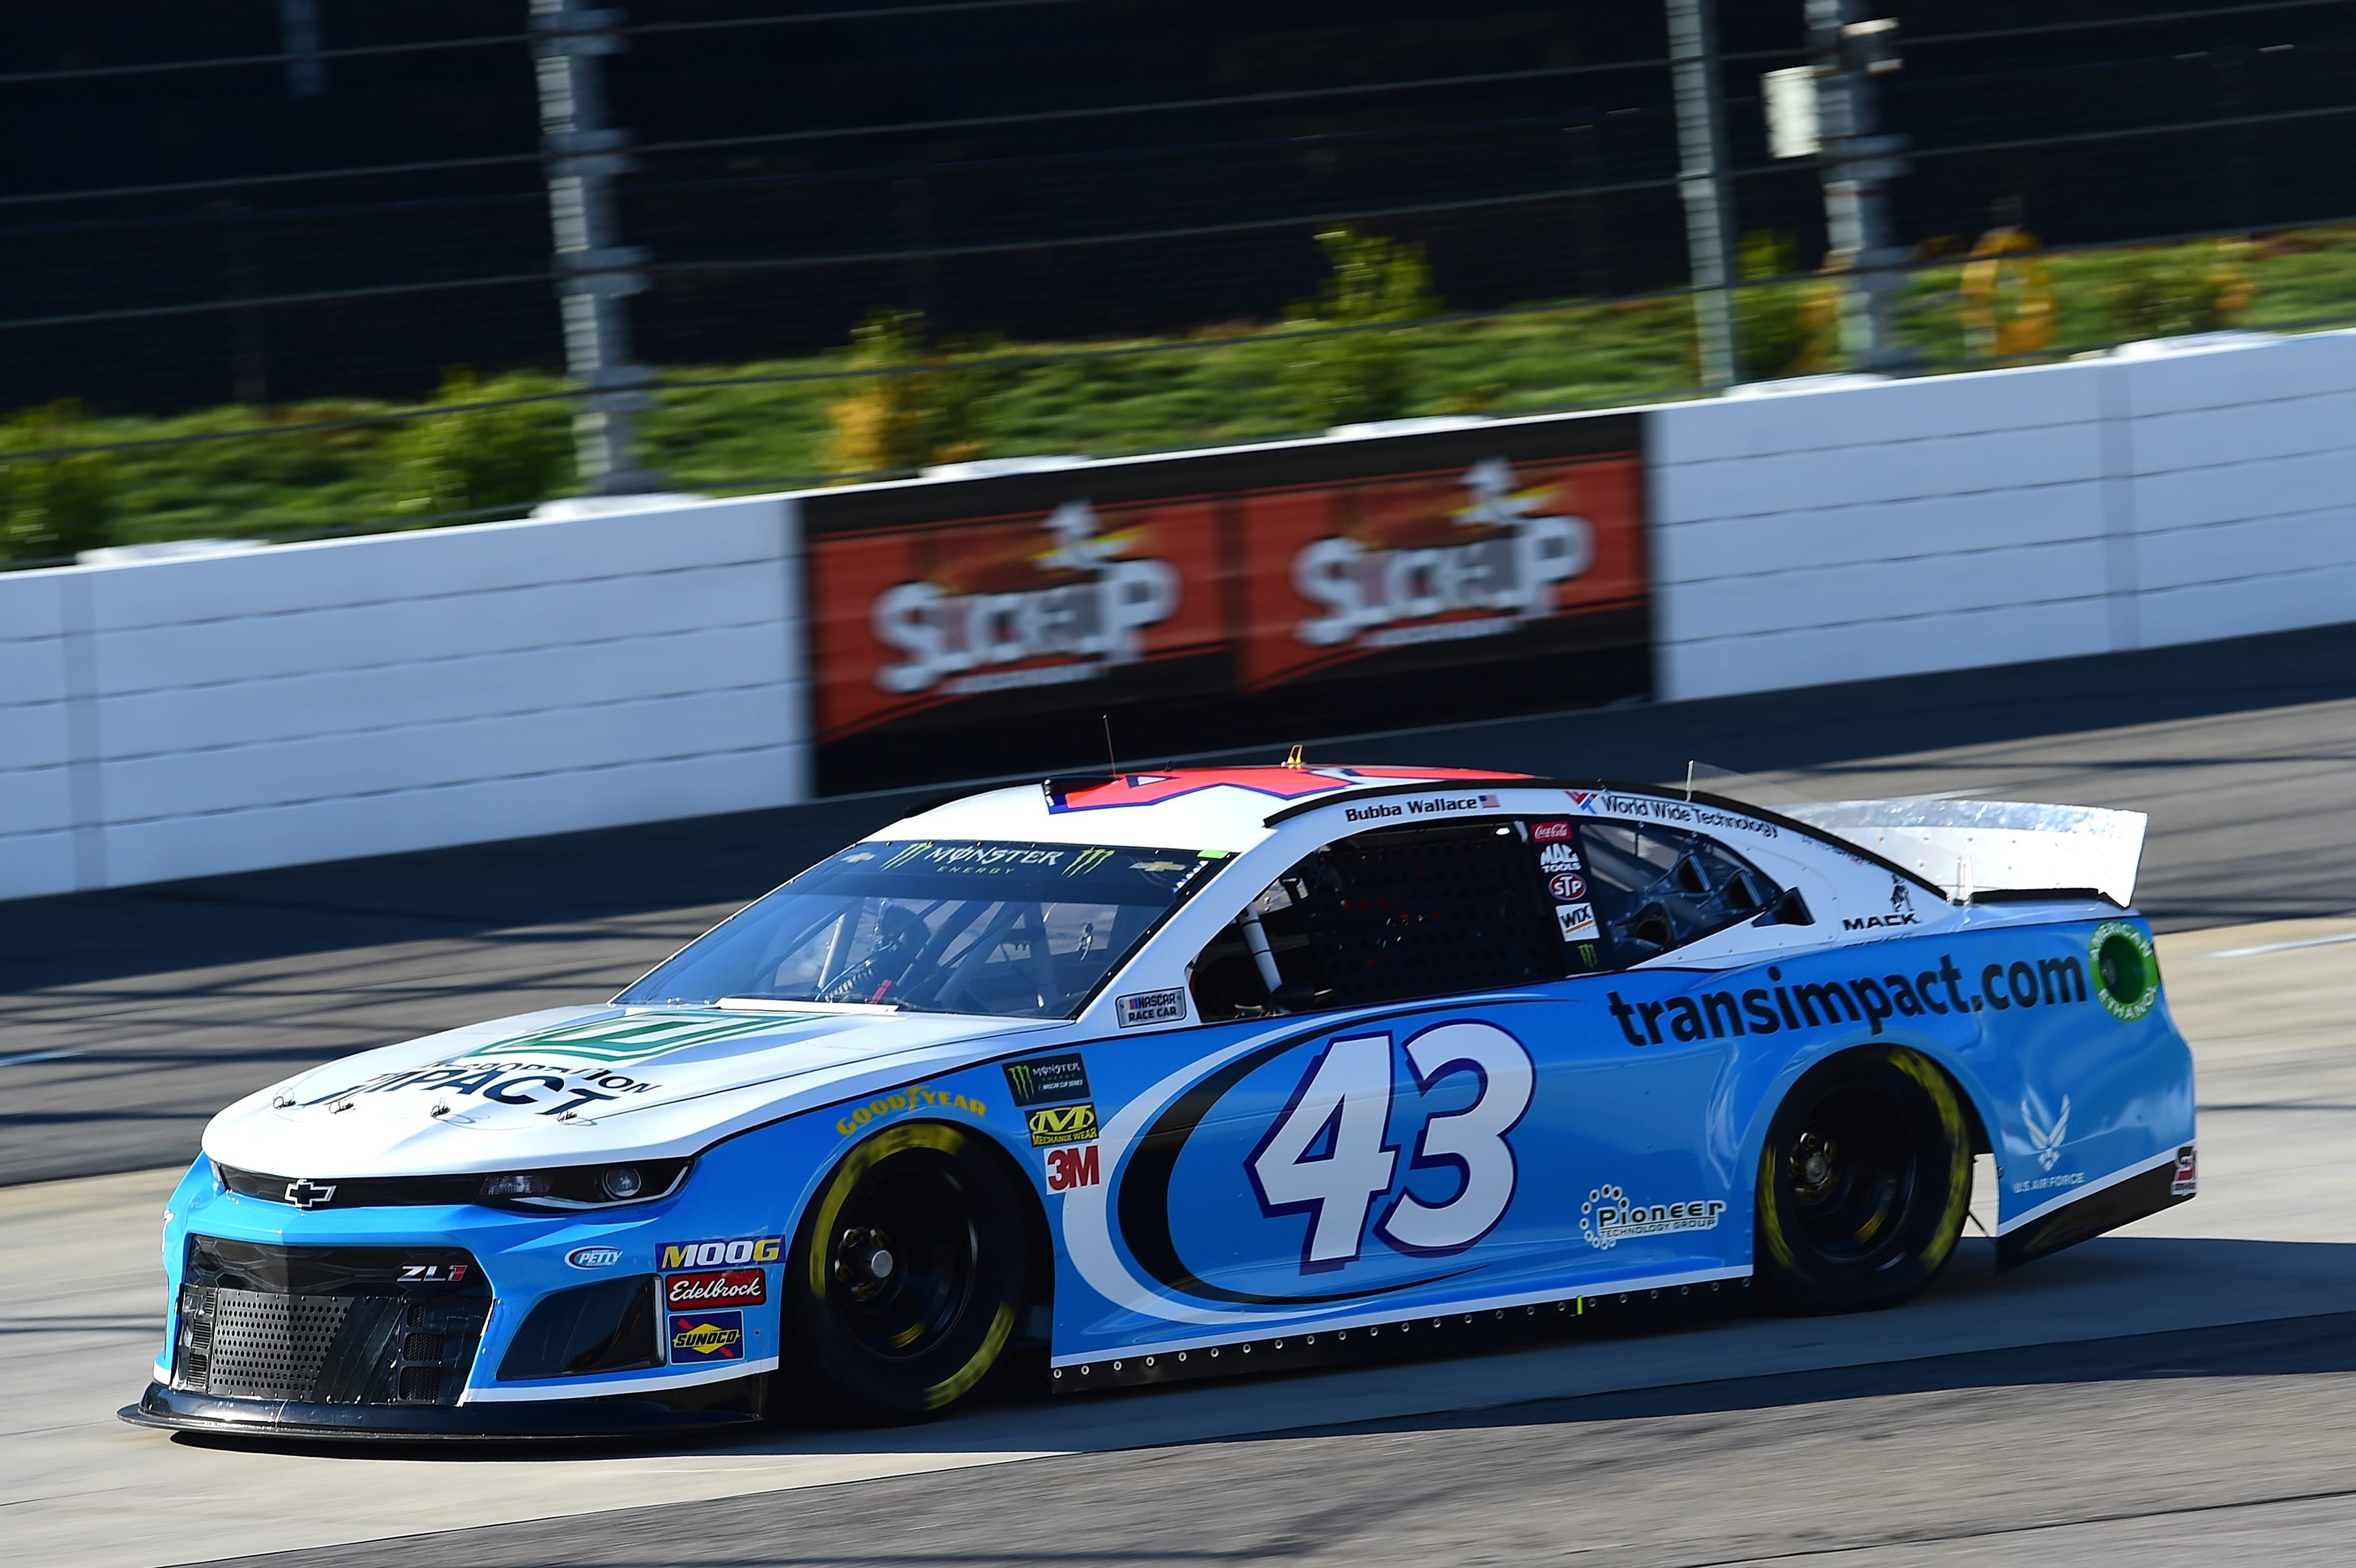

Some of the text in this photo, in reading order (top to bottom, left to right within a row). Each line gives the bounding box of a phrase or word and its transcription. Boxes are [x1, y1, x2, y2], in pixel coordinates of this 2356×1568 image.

[1345, 798, 1478, 822] Bubba Wallace
[1601, 795, 1779, 839] World Wide Technology
[1540, 844, 1579, 866] MAC
[1542, 862, 1581, 873] TOOLS
[1553, 877, 1582, 897] STP
[1561, 905, 1592, 928] WIX
[1842, 913, 1921, 931] MACK
[2090, 922, 2153, 961] AMERICAN
[1138, 993, 1176, 1009] NASCAR
[1607, 954, 2087, 1047] transimpact.com
[2098, 985, 2158, 1020] ETHANOL
[1128, 1007, 1177, 1022] RACE CAR
[837, 1091, 987, 1136] GOODYEAR
[1032, 1127, 1098, 1146] MECHANIX WEAR
[1244, 1019, 1536, 1275] 43
[1048, 1145, 1099, 1191] 3M
[2050, 1172, 2085, 1188] FORCE
[1599, 1201, 1724, 1228] Pioneer
[1600, 1219, 1716, 1238] TECHNOLOGY GROUP
[578, 1251, 623, 1264] PETTY
[662, 1238, 781, 1269] MOOG
[397, 1266, 468, 1281] ZL1
[669, 1277, 762, 1301] Edelbrock
[675, 1330, 739, 1347] SUNOCO
